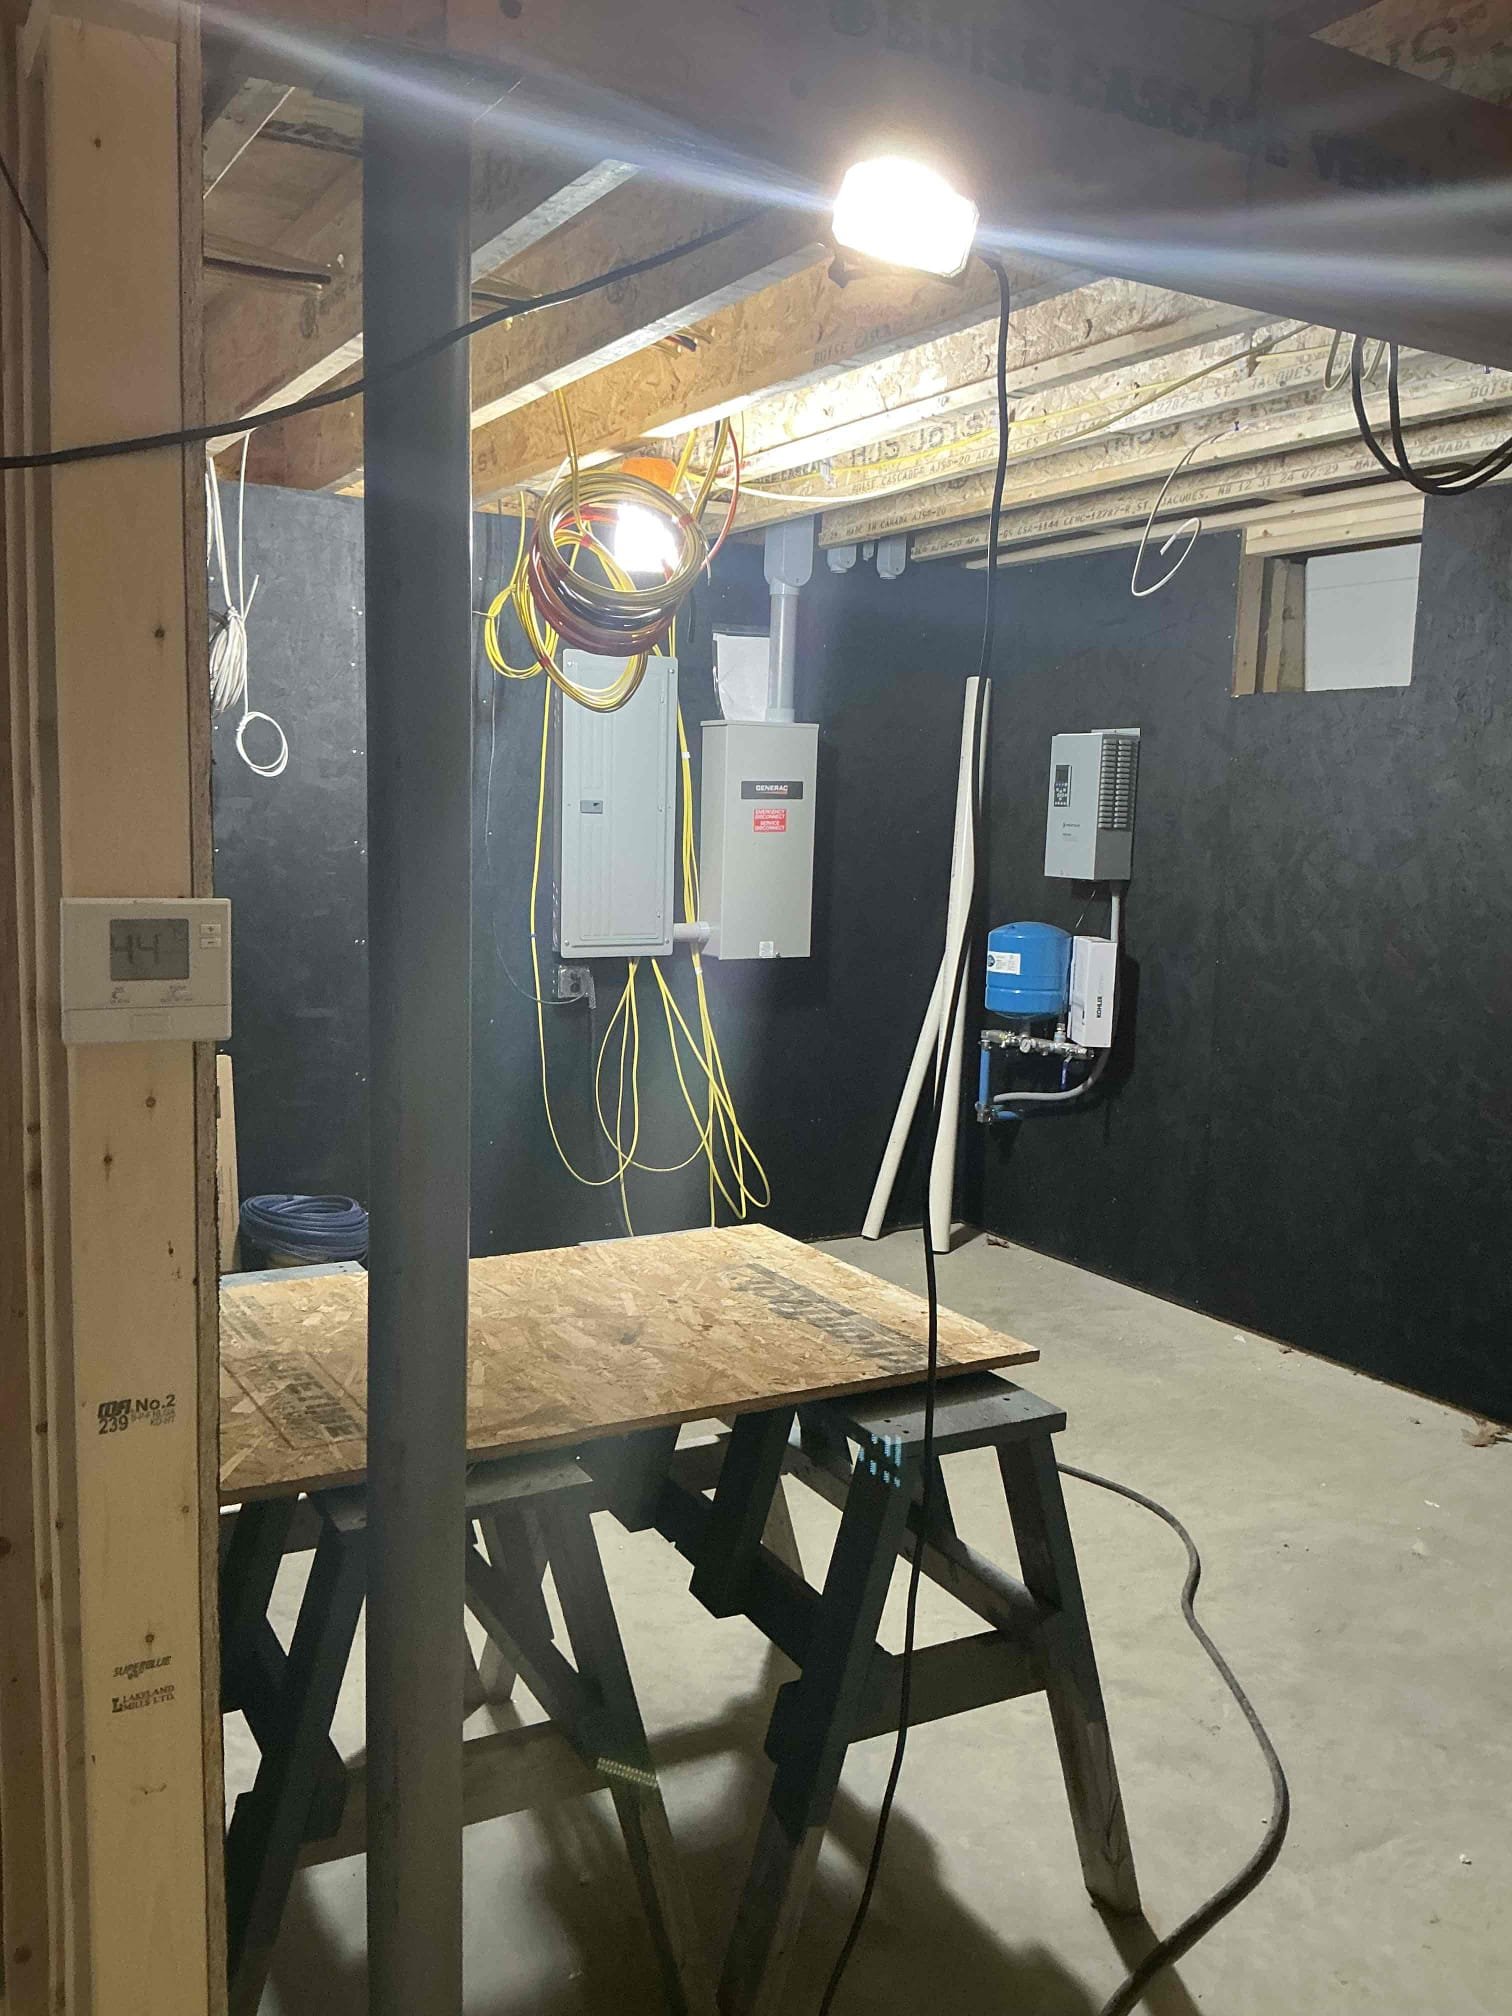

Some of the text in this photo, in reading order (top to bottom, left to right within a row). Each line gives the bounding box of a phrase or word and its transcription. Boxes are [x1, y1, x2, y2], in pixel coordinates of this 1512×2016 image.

[1470, 378, 1512, 399] BOIS
[1279, 473, 1294, 483] 24
[1420, 441, 1472, 458] CANADA
[755, 784, 789, 794] GENERAC
[135, 1394, 176, 1412] No.2
[98, 1415, 129, 1435] 239
